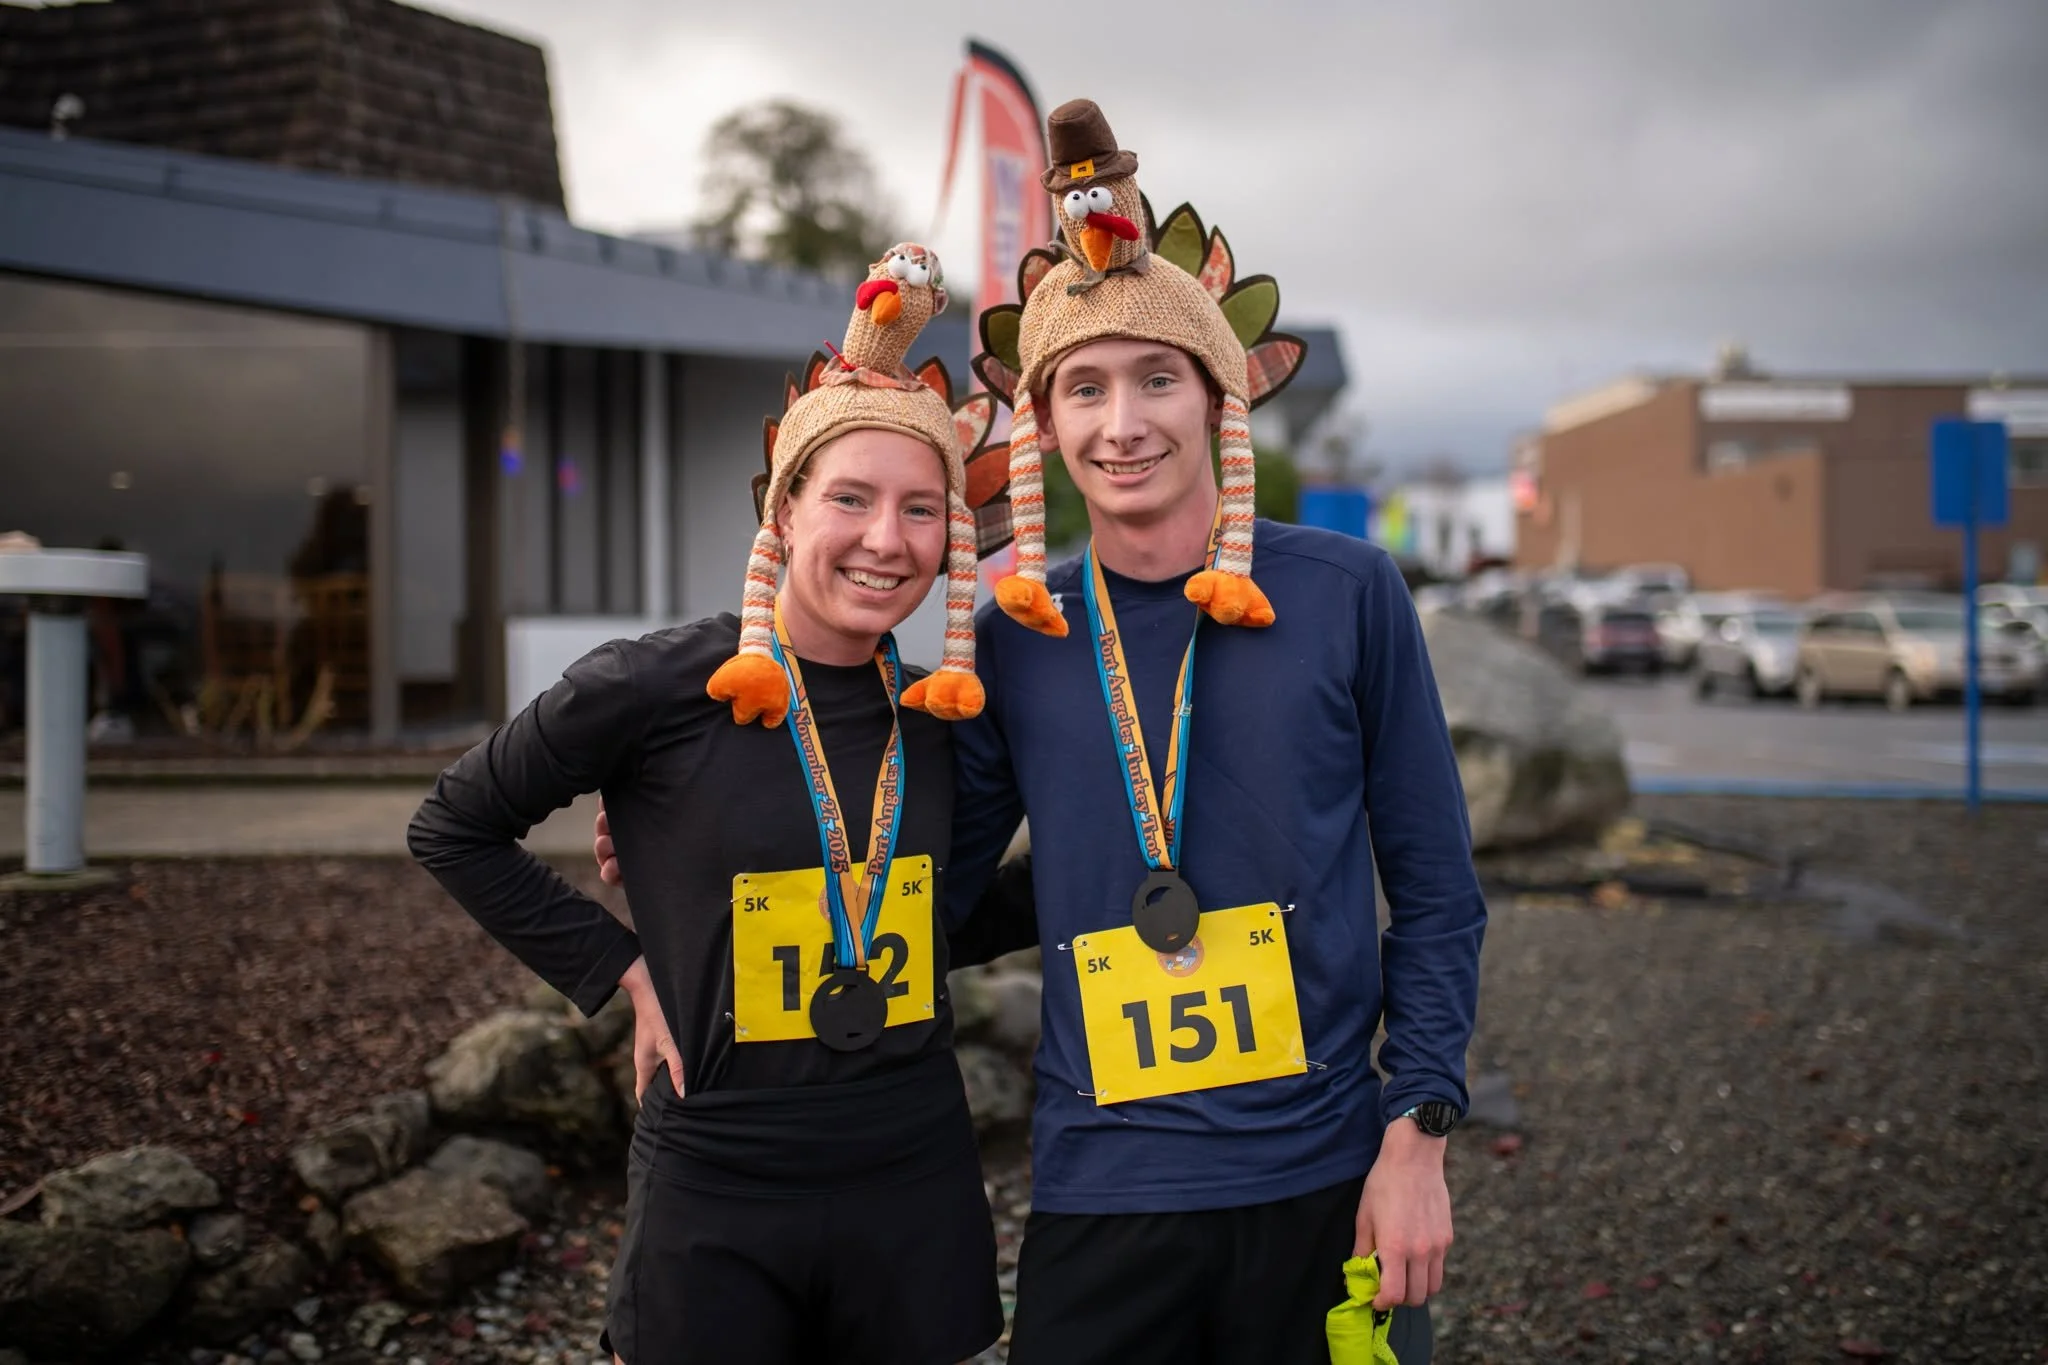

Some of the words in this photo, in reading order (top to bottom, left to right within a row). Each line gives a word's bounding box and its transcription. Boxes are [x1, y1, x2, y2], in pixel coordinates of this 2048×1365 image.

[1099, 630, 1117, 671] Port
[1107, 672, 1134, 746] Angeles
[793, 708, 827, 797] November
[875, 763, 900, 835] Angeles
[1124, 746, 1150, 814] Turkey
[819, 798, 840, 824] 27,
[827, 826, 850, 875] 2025
[868, 835, 890, 876] Port
[1140, 814, 1161, 858] Trot
[743, 896, 770, 912] 5K
[901, 880, 923, 897] 5K
[1249, 928, 1275, 946] 5K
[1087, 956, 1112, 974] 5K
[1121, 984, 1257, 1069] 151
